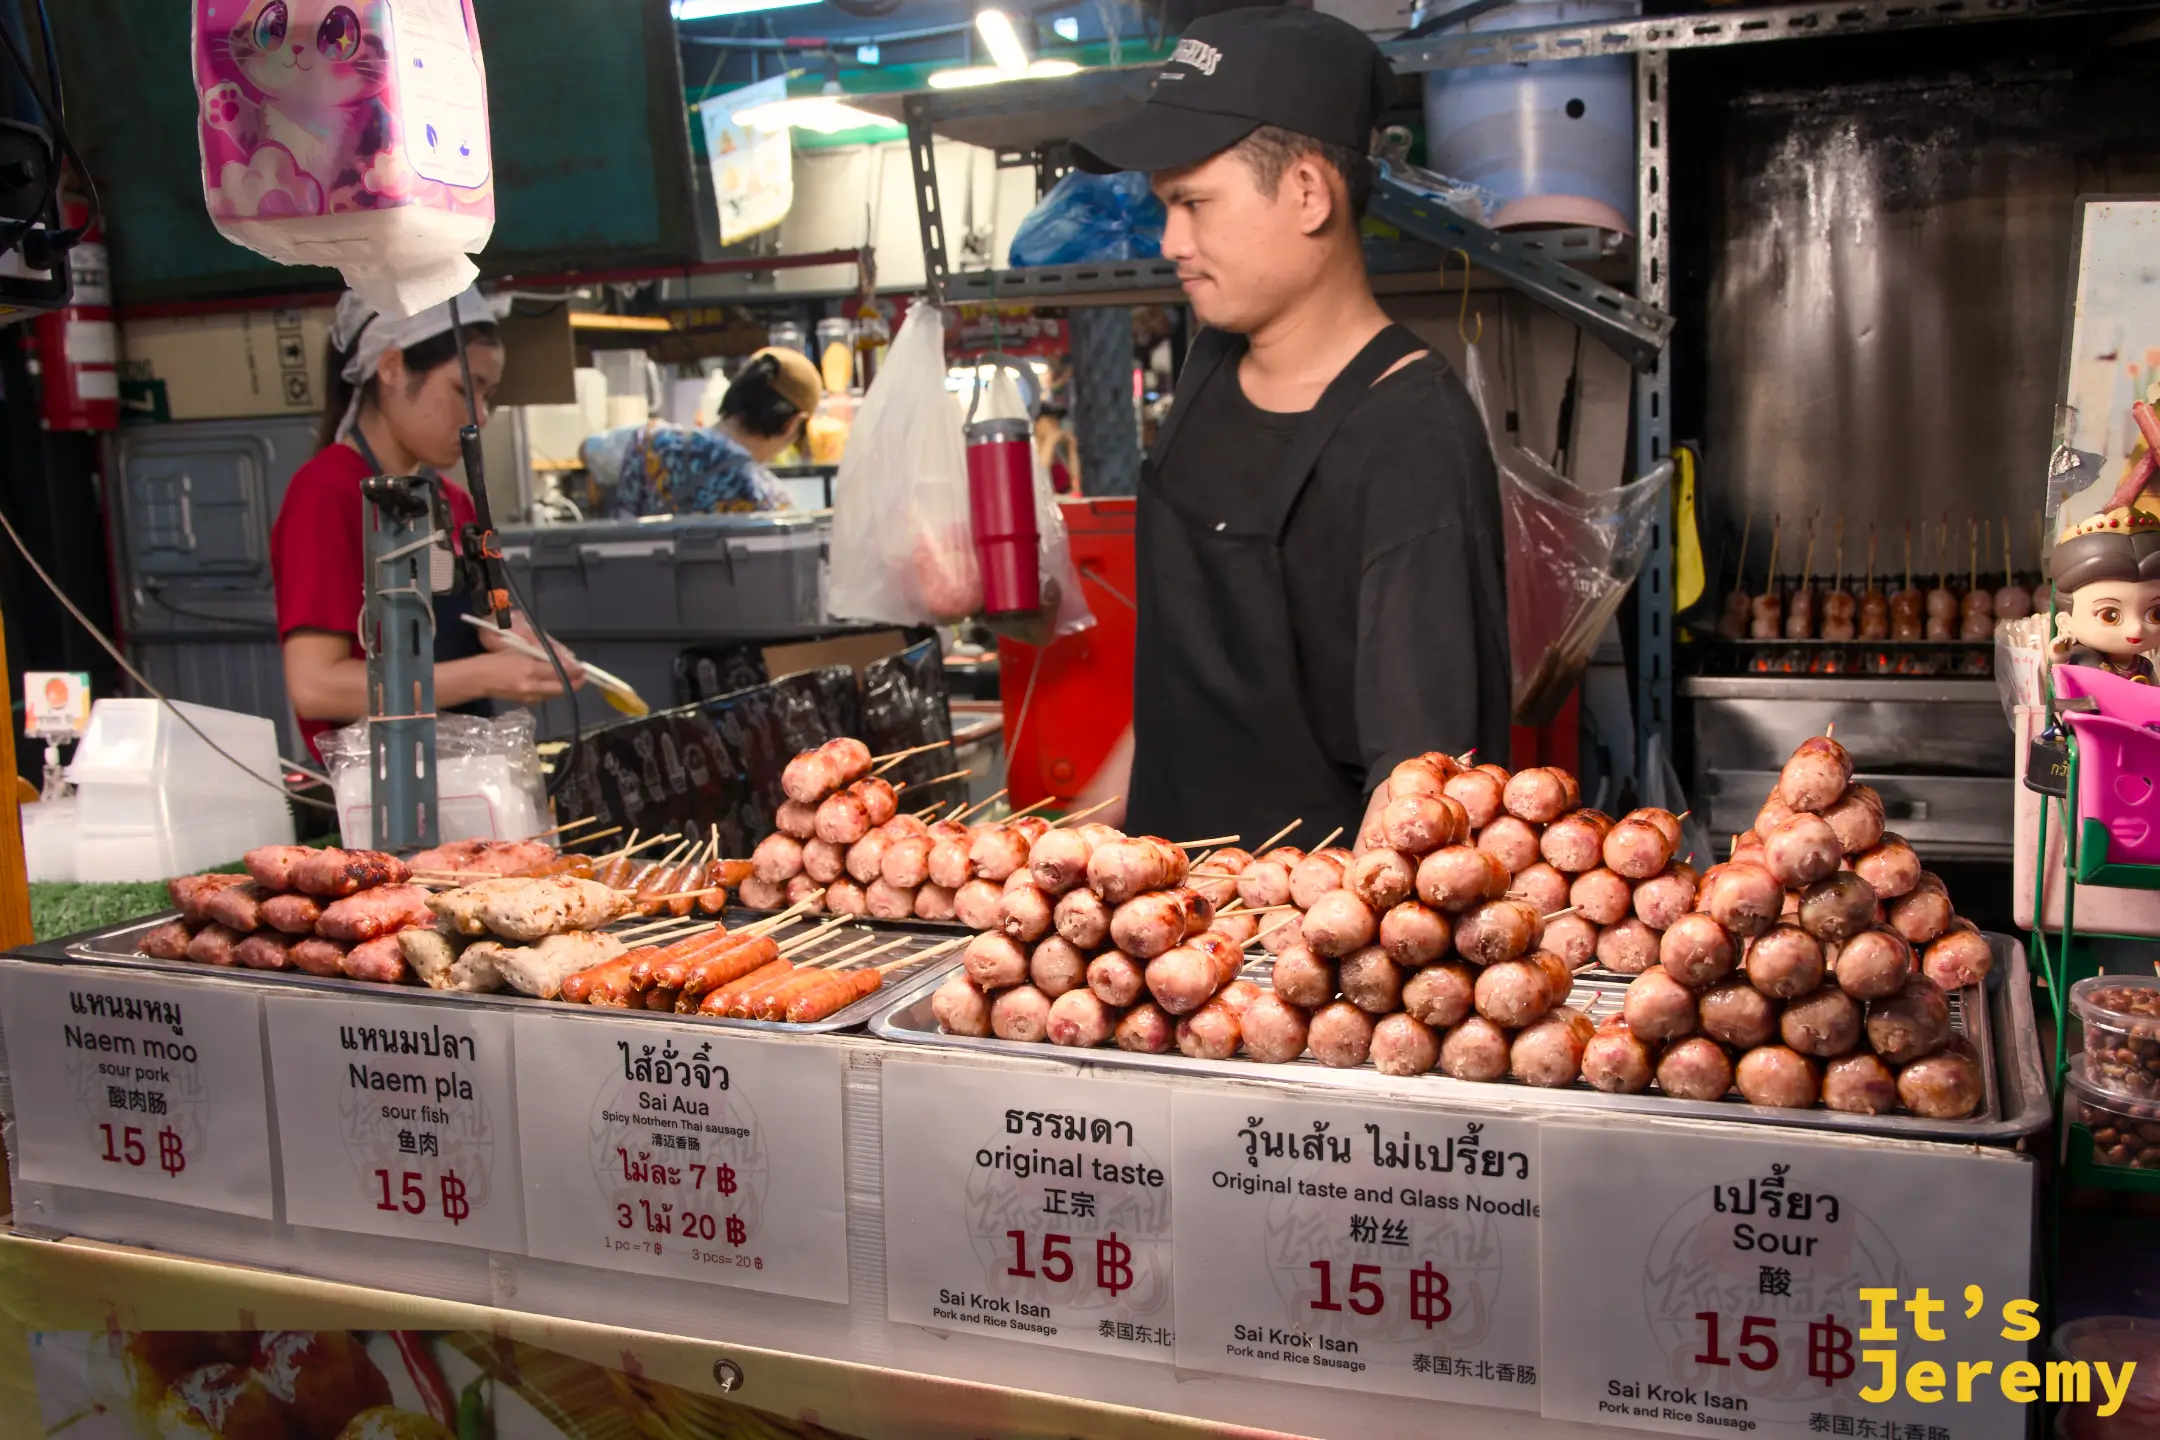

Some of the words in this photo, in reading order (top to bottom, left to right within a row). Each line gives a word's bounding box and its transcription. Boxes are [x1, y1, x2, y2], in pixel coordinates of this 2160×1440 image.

[70, 990, 183, 1036] แหนมหมู
[64, 1024, 135, 1055] Naem
[144, 1039, 197, 1063] moo
[340, 1025, 475, 1060] แหนมปลา
[99, 1063, 131, 1077] sour
[136, 1066, 170, 1082] pork
[617, 1040, 729, 1090] ไส้อั่วจิ๋ว
[349, 1063, 427, 1094] Naem
[435, 1072, 473, 1103] pla
[107, 1085, 167, 1115] 酸肉肠
[381, 1105, 416, 1121] sour
[421, 1106, 449, 1124] fish
[639, 1092, 667, 1111] Sai
[673, 1095, 709, 1116] Aua
[602, 1110, 630, 1125] Spicy
[633, 1114, 678, 1129] Notrhern
[681, 1119, 703, 1132] Thai
[705, 1124, 750, 1138] sausage
[1005, 1109, 1133, 1147] ธรรมดา
[100, 1123, 146, 1166] 15
[397, 1128, 439, 1157] 鱼肉
[651, 1133, 700, 1151] 清迈香肠
[1237, 1116, 1351, 1168] วุ้นเส้น
[1364, 1122, 1529, 1180] ไม่เปรี้ยว
[617, 1148, 681, 1186] ไม้ละ
[689, 1163, 706, 1189] 7
[976, 1145, 1082, 1179] original
[1092, 1157, 1164, 1188] taste
[375, 1169, 426, 1215] 15
[1043, 1187, 1096, 1218] 正宗
[1212, 1171, 1292, 1195] Original
[1298, 1179, 1348, 1200] taste
[1354, 1185, 1393, 1204] and
[1400, 1188, 1459, 1211] Glass
[1713, 1163, 1840, 1224] เปรี้ยว
[617, 1203, 633, 1229] 3
[639, 1198, 673, 1234] ไม้
[681, 1212, 716, 1240] 20
[1350, 1214, 1409, 1246] 粉丝
[615, 1239, 630, 1251] pc
[1006, 1230, 1074, 1283] 15
[1732, 1224, 1819, 1257] Sour
[736, 1255, 751, 1267] 20
[1310, 1260, 1385, 1316] 15
[1759, 1265, 1792, 1297] 酸
[939, 1289, 965, 1306] Sai
[970, 1293, 1011, 1313] Krok
[1015, 1300, 1050, 1318] Isan
[933, 1308, 957, 1320] Pork
[960, 1311, 980, 1324] and
[983, 1315, 1007, 1328] Rice
[1010, 1319, 1057, 1335] Sausage
[1098, 1319, 1175, 1346] 泰国东北
[1234, 1325, 1262, 1342] Sai
[1269, 1329, 1313, 1348] Krok
[1319, 1335, 1358, 1354] Isan
[1694, 1311, 1779, 1372] 15
[1227, 1345, 1254, 1358] Pork
[1257, 1348, 1279, 1361] and
[1283, 1352, 1309, 1365] Rice
[1313, 1355, 1366, 1372] Sausage
[1412, 1354, 1536, 1385] 泰国东北香肠
[1608, 1379, 1641, 1399] Sai
[1647, 1383, 1697, 1406] Krok
[1703, 1391, 1748, 1412] Isan
[1599, 1402, 1629, 1415] Pork
[1633, 1404, 1658, 1418] and
[1662, 1408, 1692, 1422] Rice
[1696, 1410, 1756, 1431] Sausage
